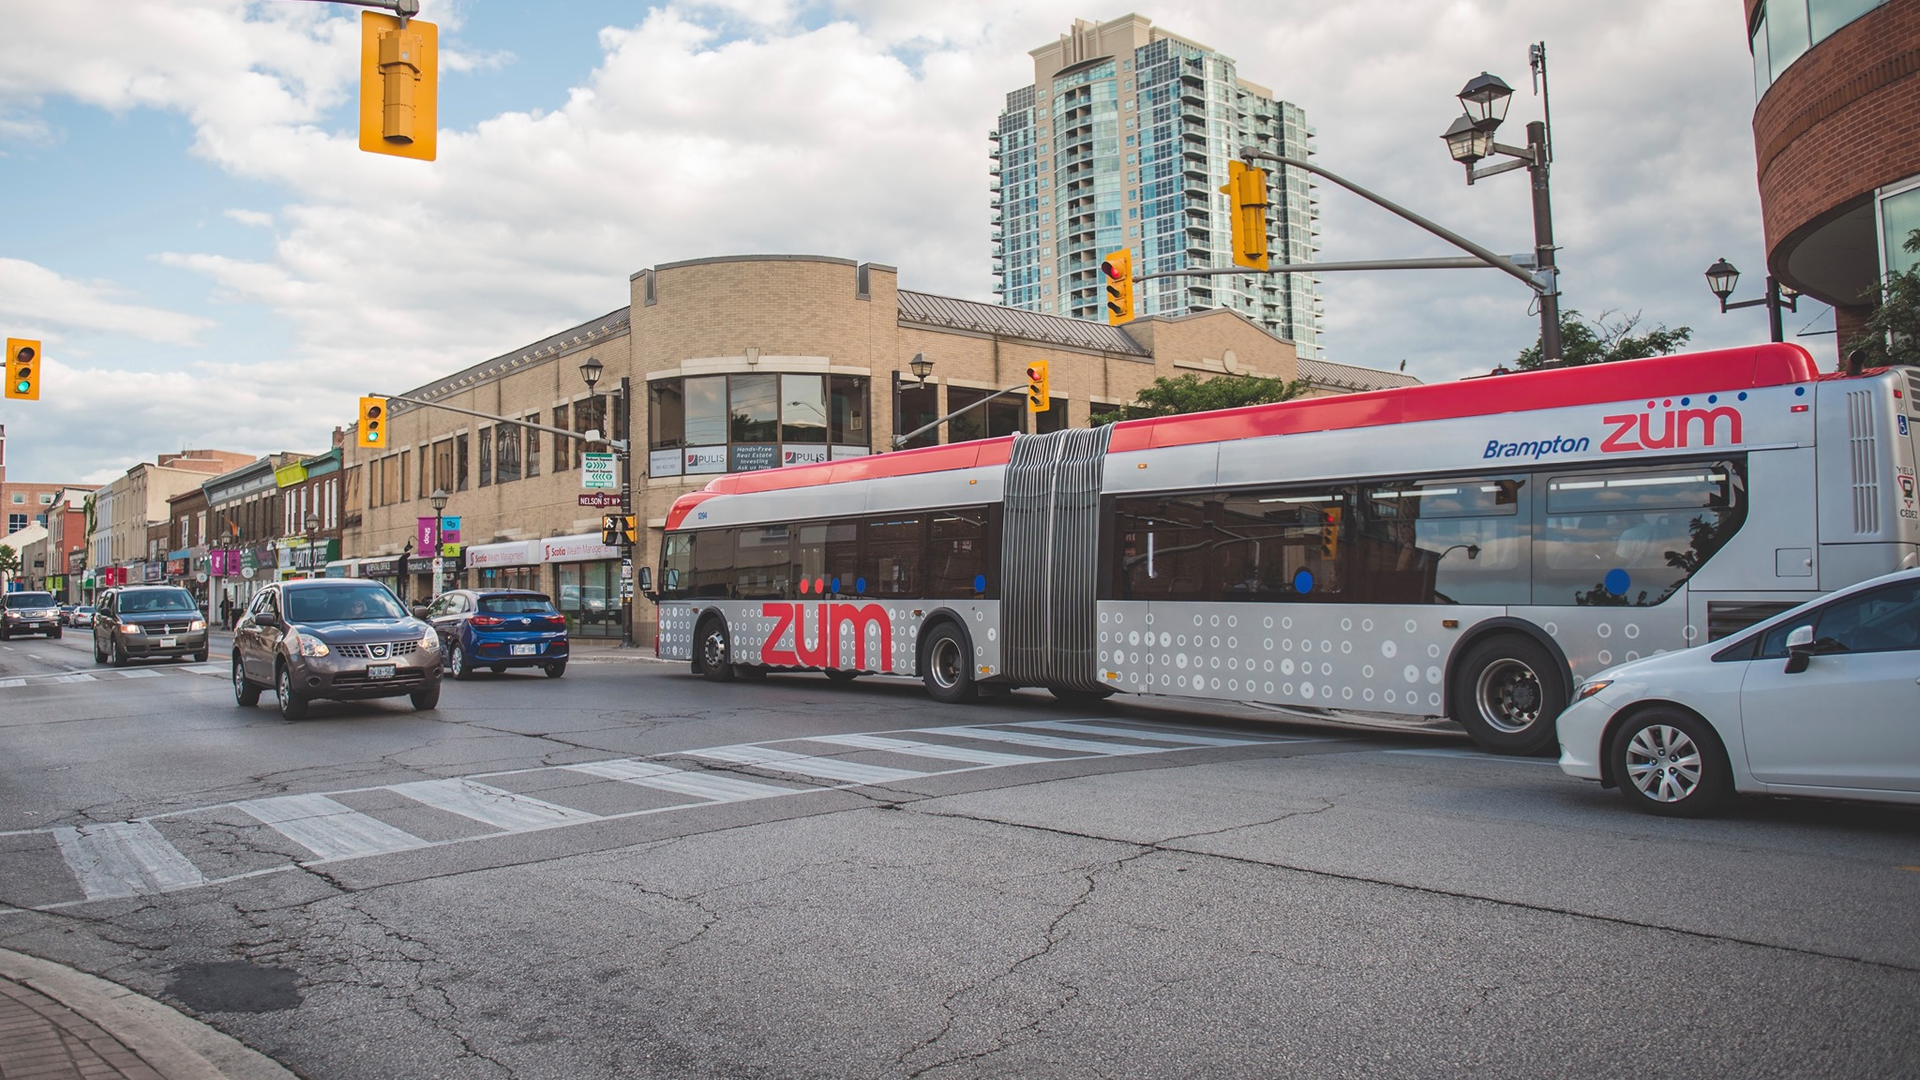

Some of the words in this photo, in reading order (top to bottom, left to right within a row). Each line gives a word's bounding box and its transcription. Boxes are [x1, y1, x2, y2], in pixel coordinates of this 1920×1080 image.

[1483, 435, 1590, 460] Brampton
[698, 454, 724, 464] PULIS
[796, 452, 825, 462] PULIS
[1896, 466, 1914, 476] YIELD
[580, 497, 602, 505] NELSON
[603, 497, 611, 505] ST
[423, 527, 431, 544] Shop
[551, 547, 566, 556] Scotia
[567, 546, 582, 555] Wealth
[583, 543, 612, 556] Management
[488, 553, 500, 561] Wealth
[501, 552, 525, 563] Management
